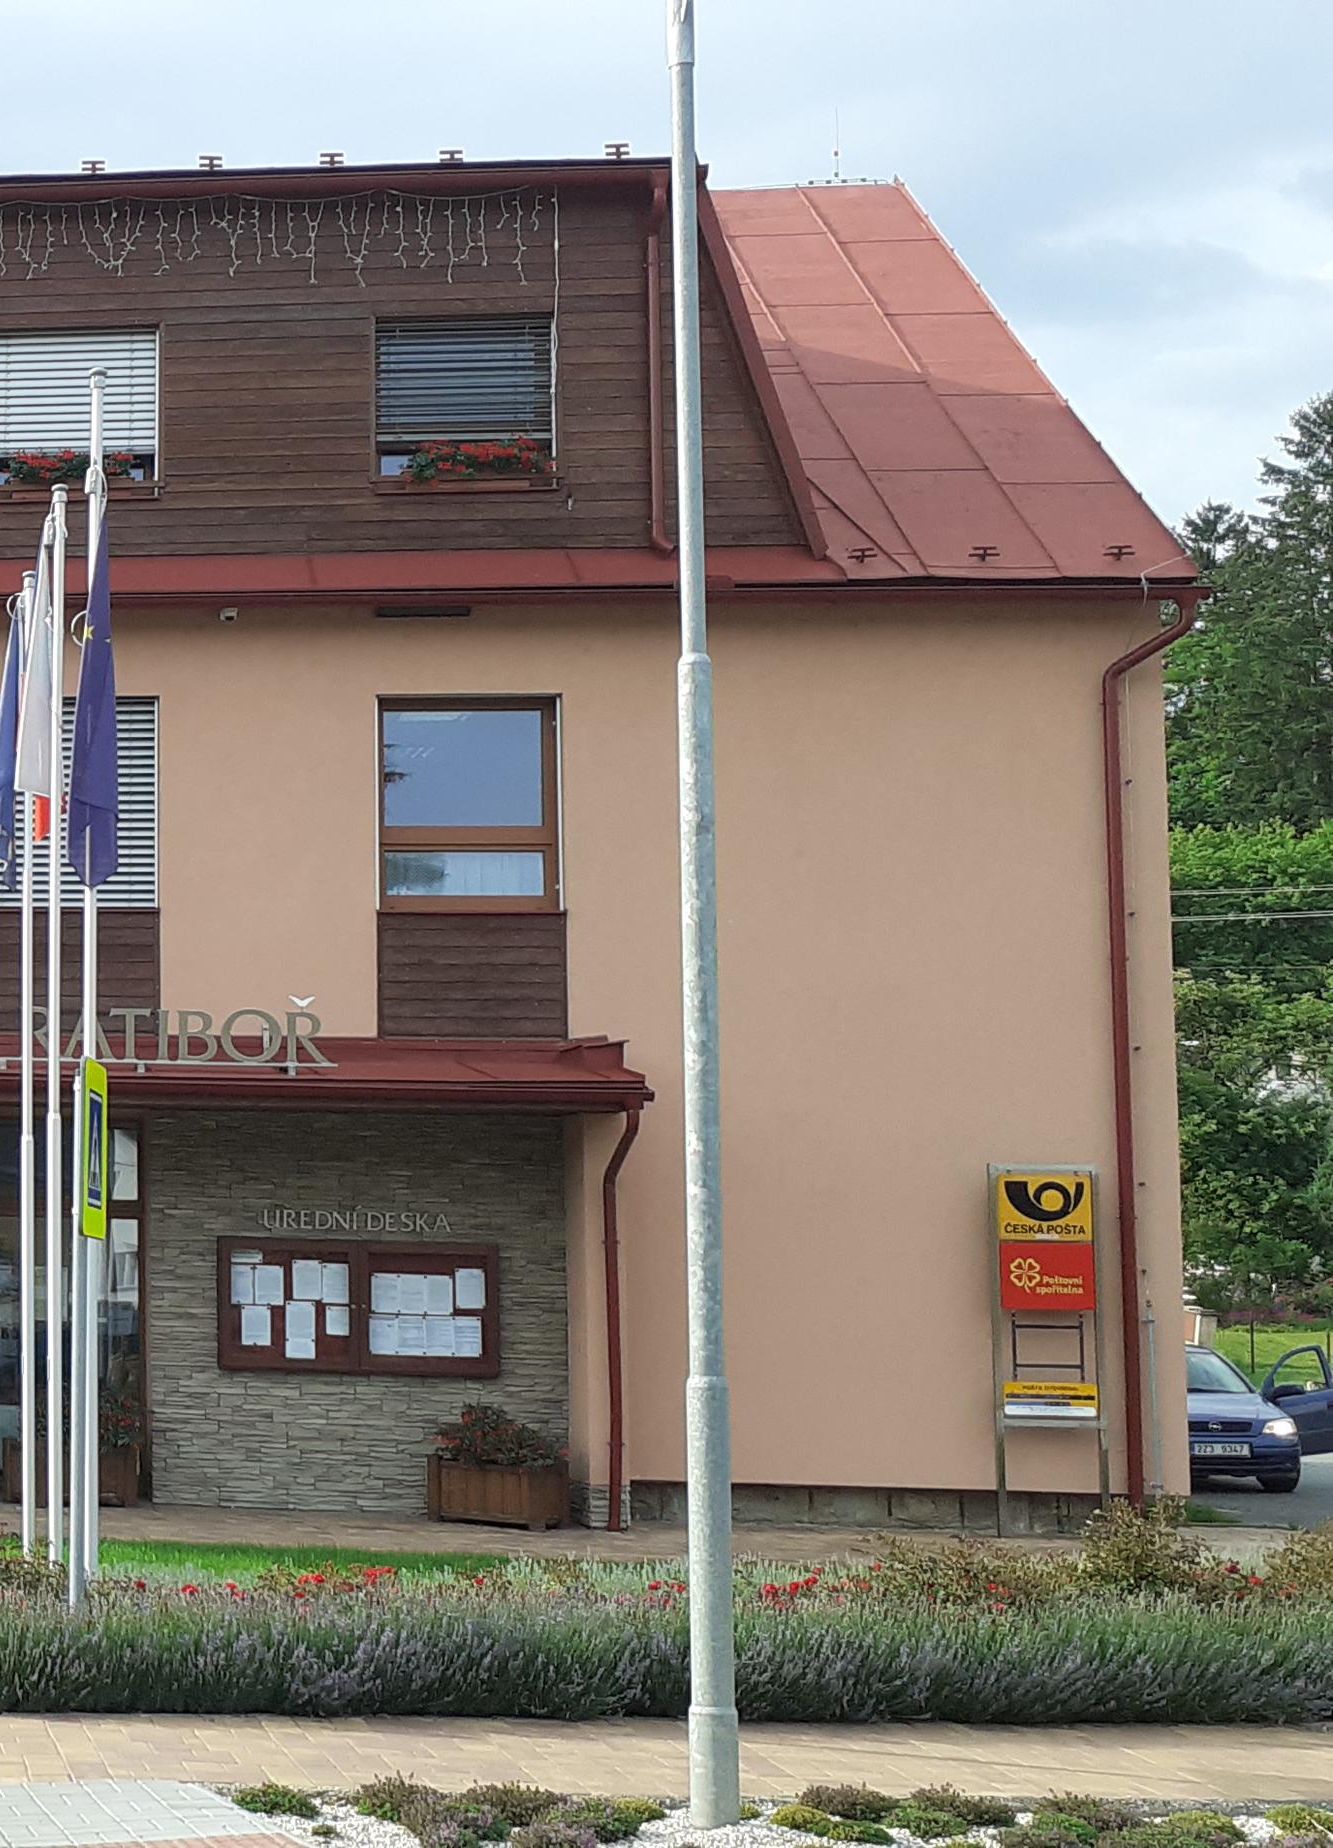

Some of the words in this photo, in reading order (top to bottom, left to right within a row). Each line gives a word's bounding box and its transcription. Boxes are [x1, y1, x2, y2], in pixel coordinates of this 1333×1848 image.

[30, 994, 333, 1065] RATIBOŘ
[366, 1210, 452, 1233] DESKA
[1004, 1222, 1044, 1234] ČESKÁ
[1046, 1223, 1086, 1235] POŠTA
